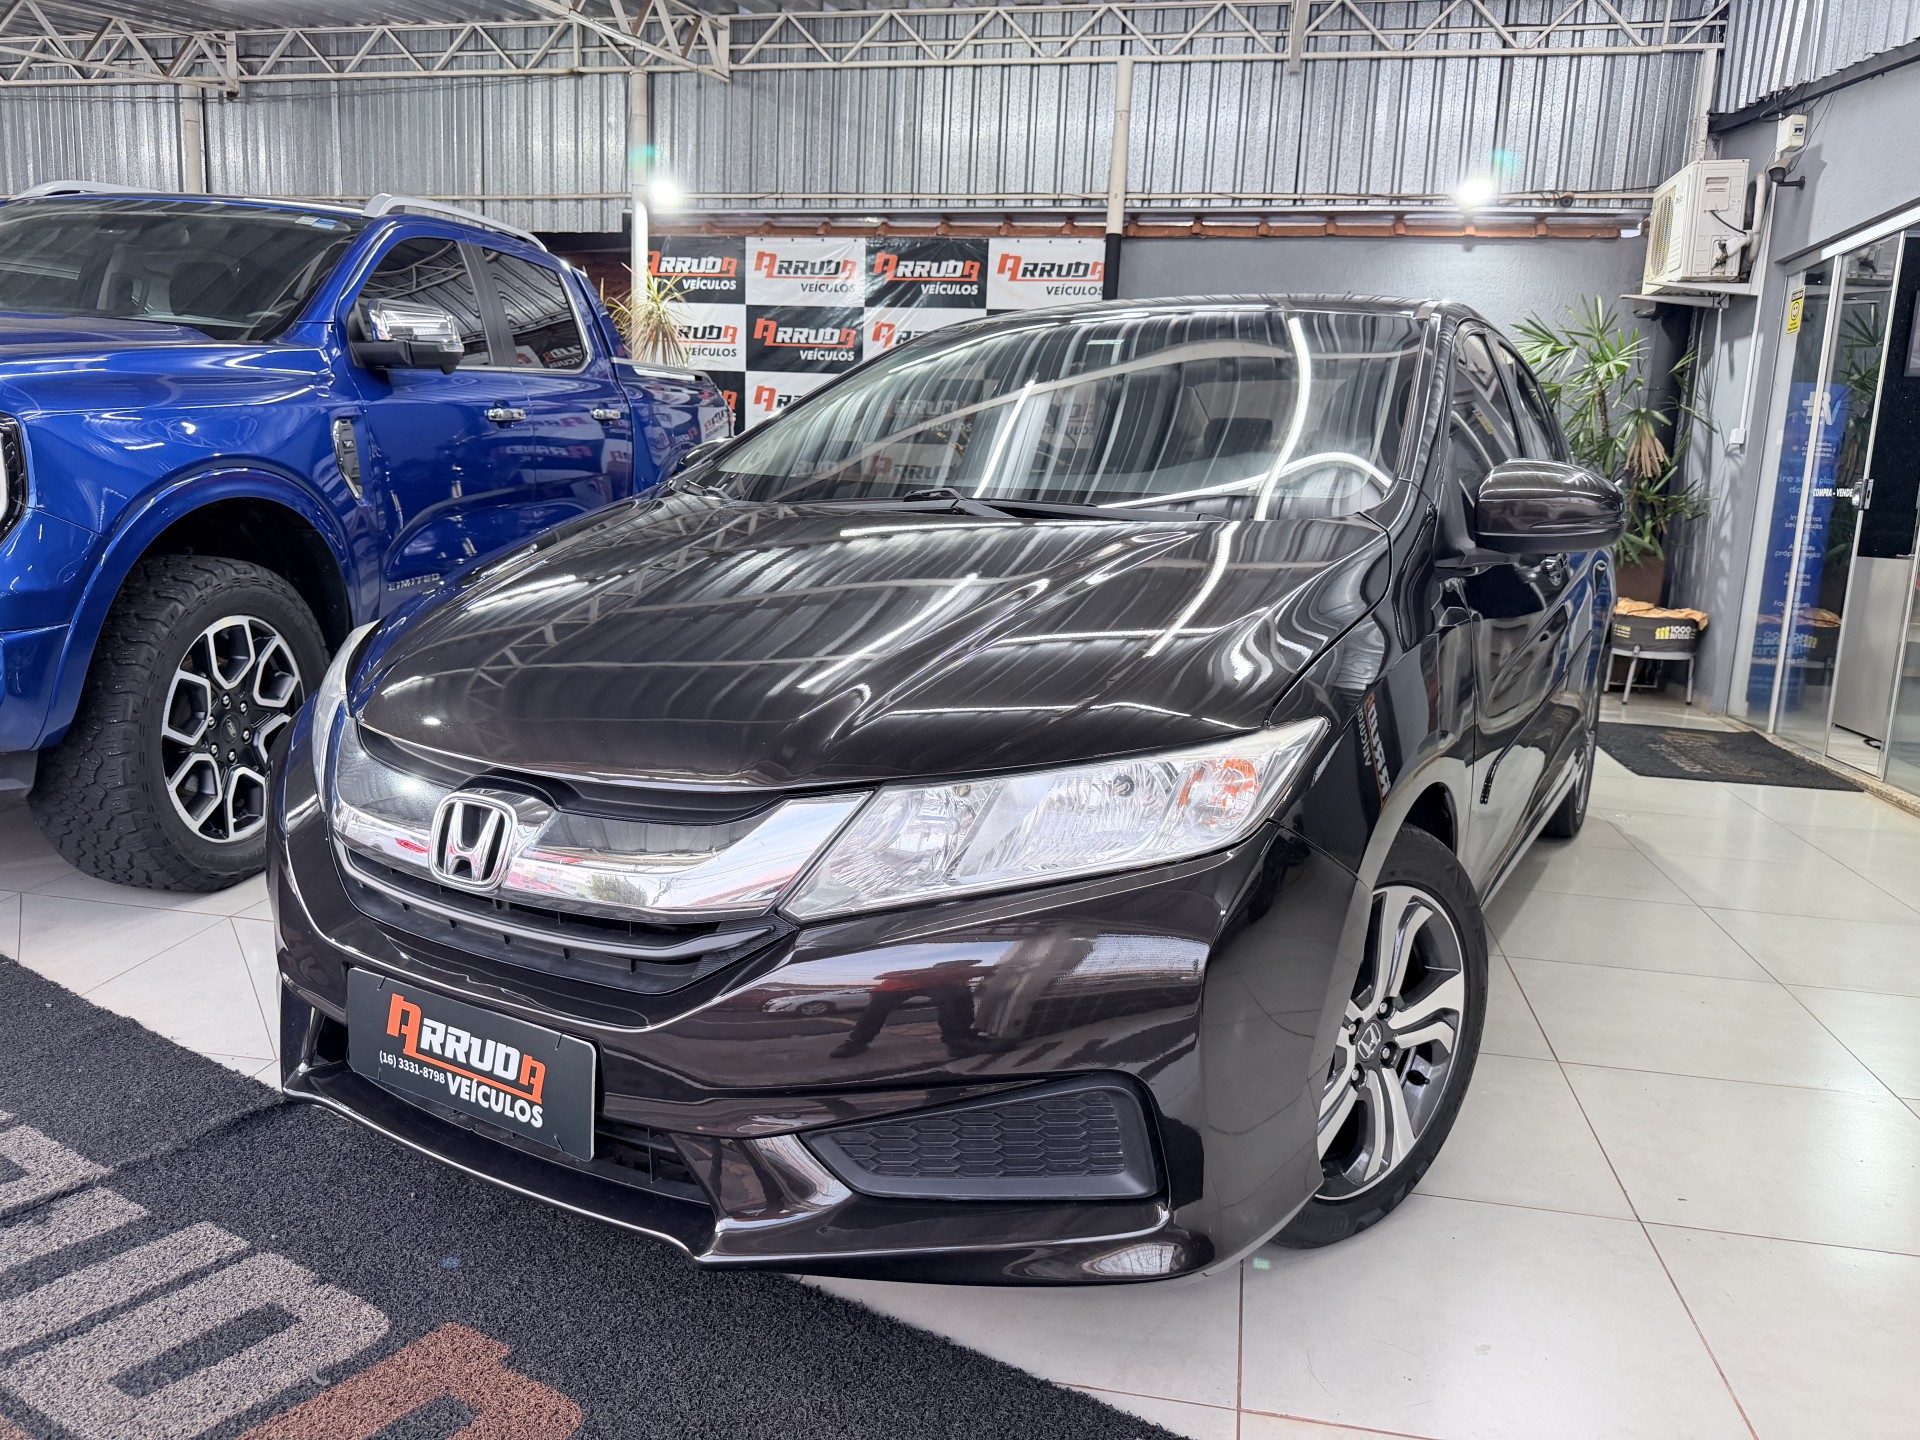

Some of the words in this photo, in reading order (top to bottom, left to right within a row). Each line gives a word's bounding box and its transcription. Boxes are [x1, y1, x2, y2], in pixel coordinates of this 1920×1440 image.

[648, 251, 738, 278] ARRUDA
[754, 251, 857, 279] ARRUDA
[873, 252, 980, 281] ARRUDA
[996, 253, 1104, 281] ARRUDA
[682, 277, 737, 290] VEÍCULOS
[801, 281, 856, 293] VEÍCULOS
[920, 281, 979, 295] VEÍCULOS
[753, 318, 857, 348] ARRUDA
[799, 347, 855, 361] VEÍCULOS
[1812, 487, 1833, 498] COMPRA
[1836, 487, 1854, 498] VENDE
[387, 573, 440, 592] LIMITED
[386, 993, 547, 1105] ARRUDA
[378, 1049, 398, 1069] (16)
[397, 1056, 446, 1085] 3331-8798
[445, 1071, 544, 1129] VEÍCULOS
